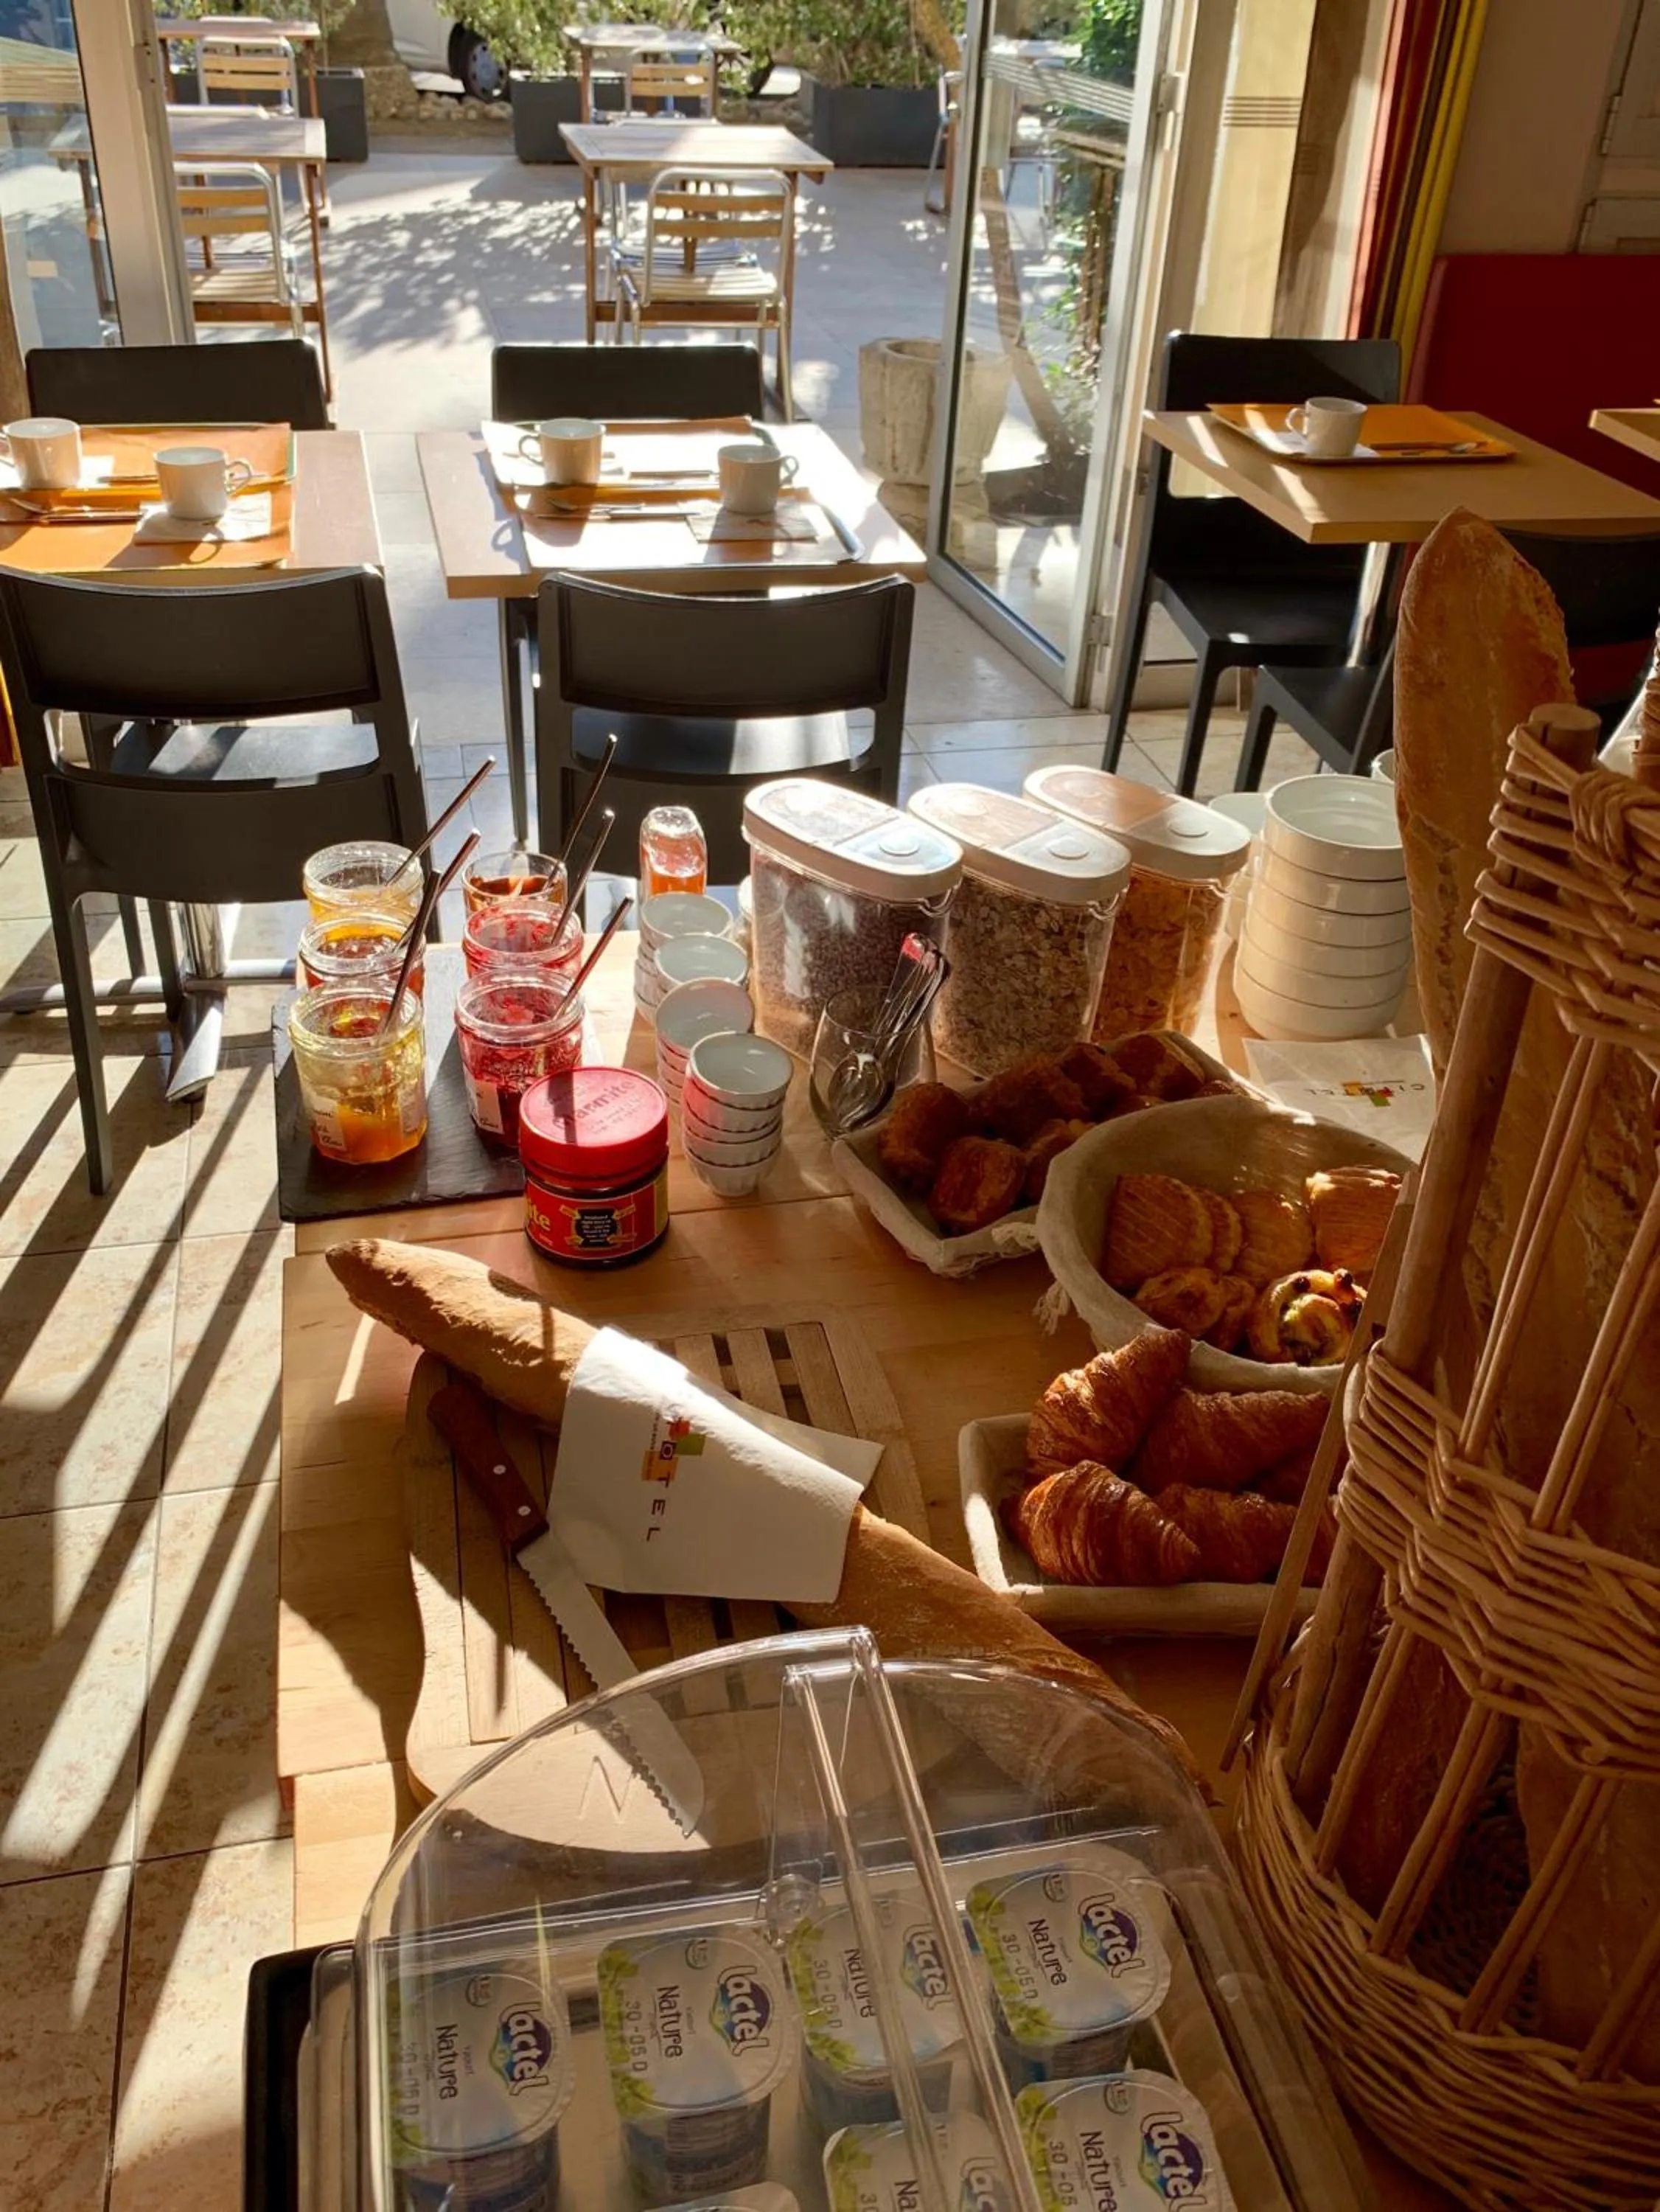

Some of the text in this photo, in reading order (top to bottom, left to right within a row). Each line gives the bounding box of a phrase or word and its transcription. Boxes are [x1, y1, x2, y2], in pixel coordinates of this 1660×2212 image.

[1029, 1919, 1067, 1986] Nature
[1078, 1892, 1143, 1978] lactel
[657, 1984, 683, 2058] Nature
[715, 1966, 769, 2056] lactel
[845, 1947, 877, 2019] Nature
[436, 2024, 458, 2100] Nature
[499, 2002, 550, 2096] lactel
[1080, 2131, 1117, 2212] Nature
